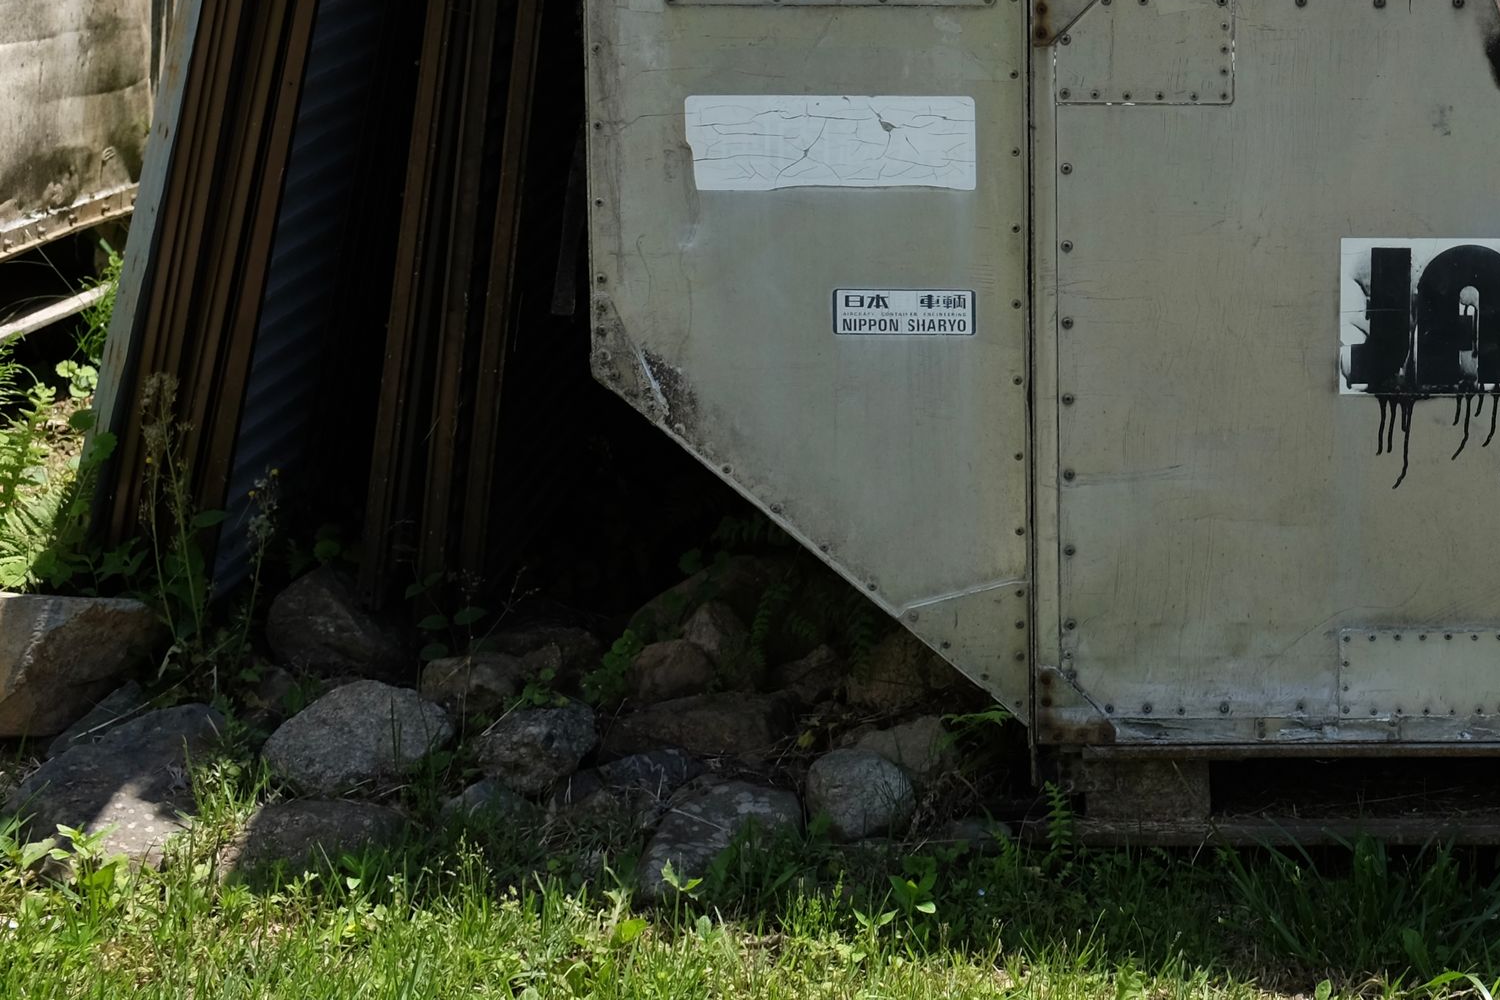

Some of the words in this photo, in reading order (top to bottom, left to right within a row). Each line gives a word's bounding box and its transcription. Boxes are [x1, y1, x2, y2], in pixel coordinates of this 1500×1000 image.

[844, 294, 889, 309] 日本
[842, 318, 899, 332] NIPPON
[907, 318, 967, 333] SHARYO
